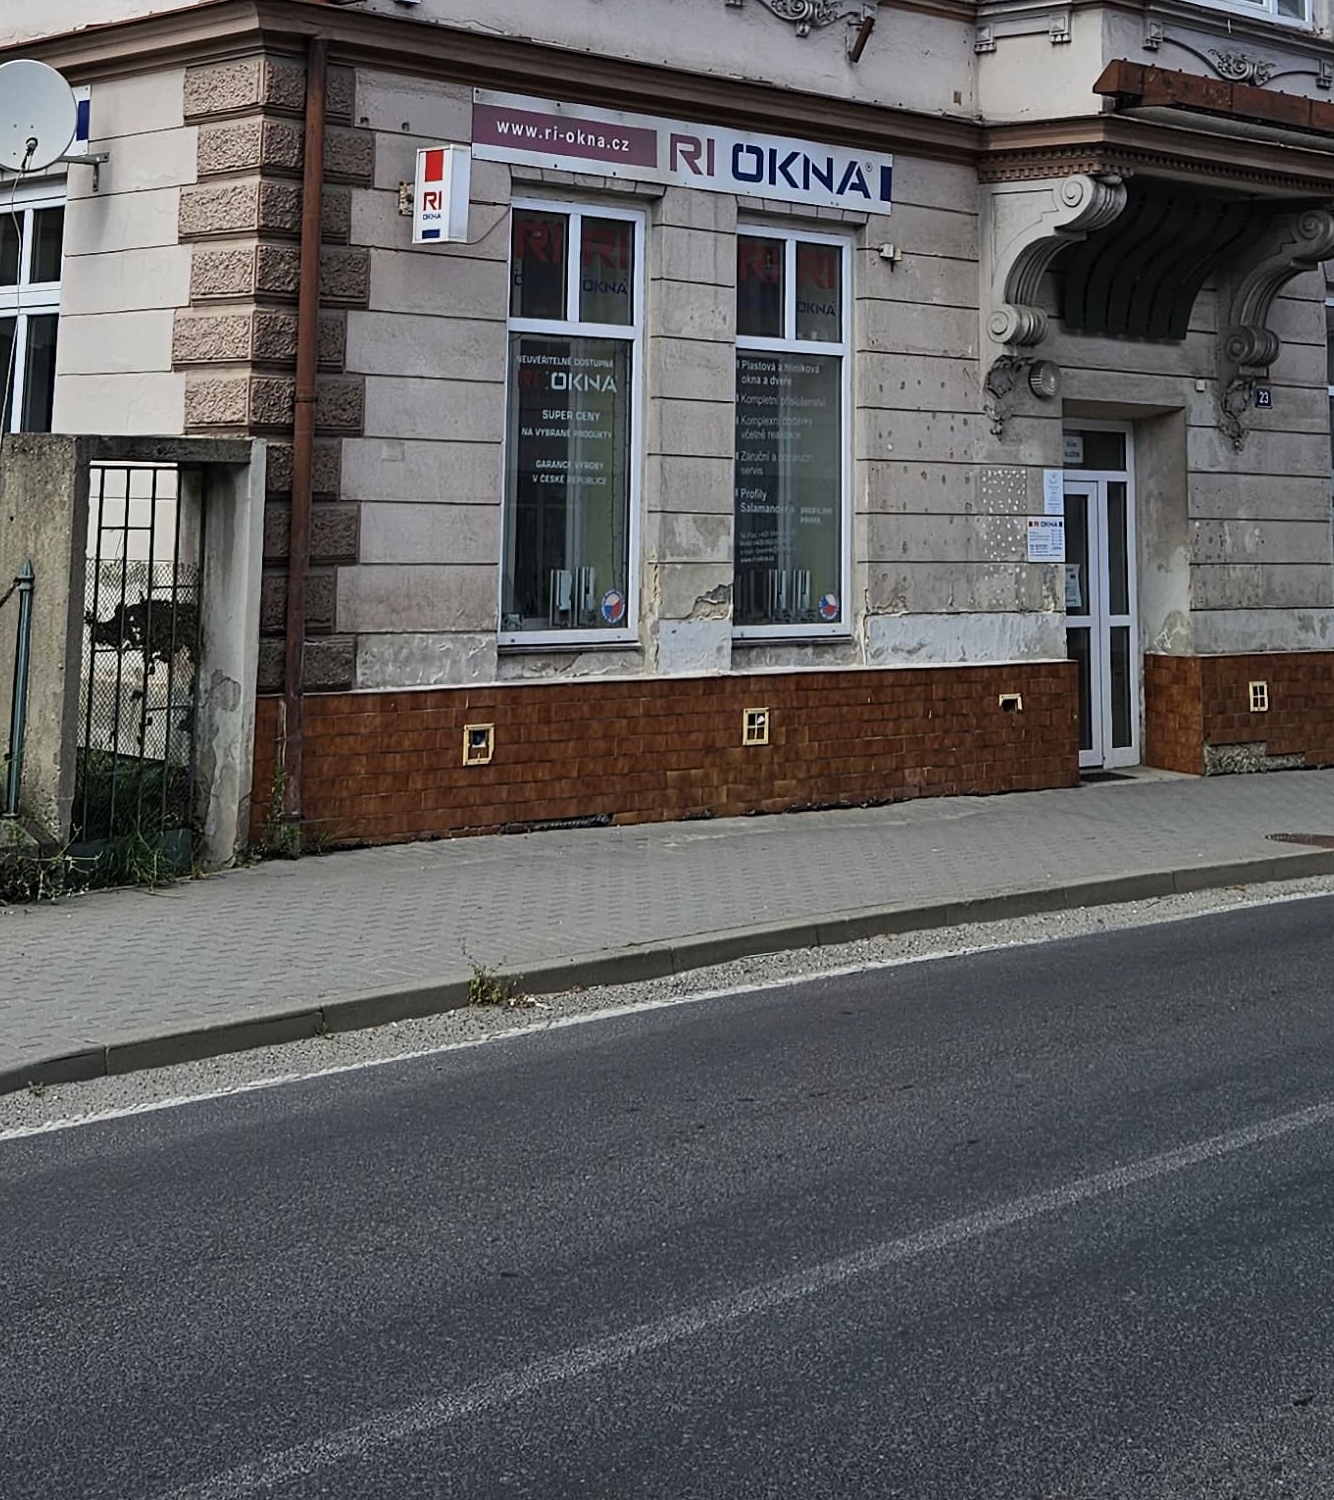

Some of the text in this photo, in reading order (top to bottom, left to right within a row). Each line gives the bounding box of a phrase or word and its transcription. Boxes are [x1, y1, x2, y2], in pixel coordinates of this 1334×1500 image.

[496, 120, 630, 152] www.ri-okna.cz
[670, 133, 715, 177] RI
[423, 191, 442, 211] RI
[422, 213, 442, 221] OKNA
[583, 279, 628, 294] OKNA
[797, 301, 836, 316] OKNA
[551, 371, 617, 393] OKNA
[1259, 391, 1269, 404] 23
[542, 409, 602, 421] SUPER CENY
[521, 427, 533, 437] NA
[740, 487, 767, 501] Profily
